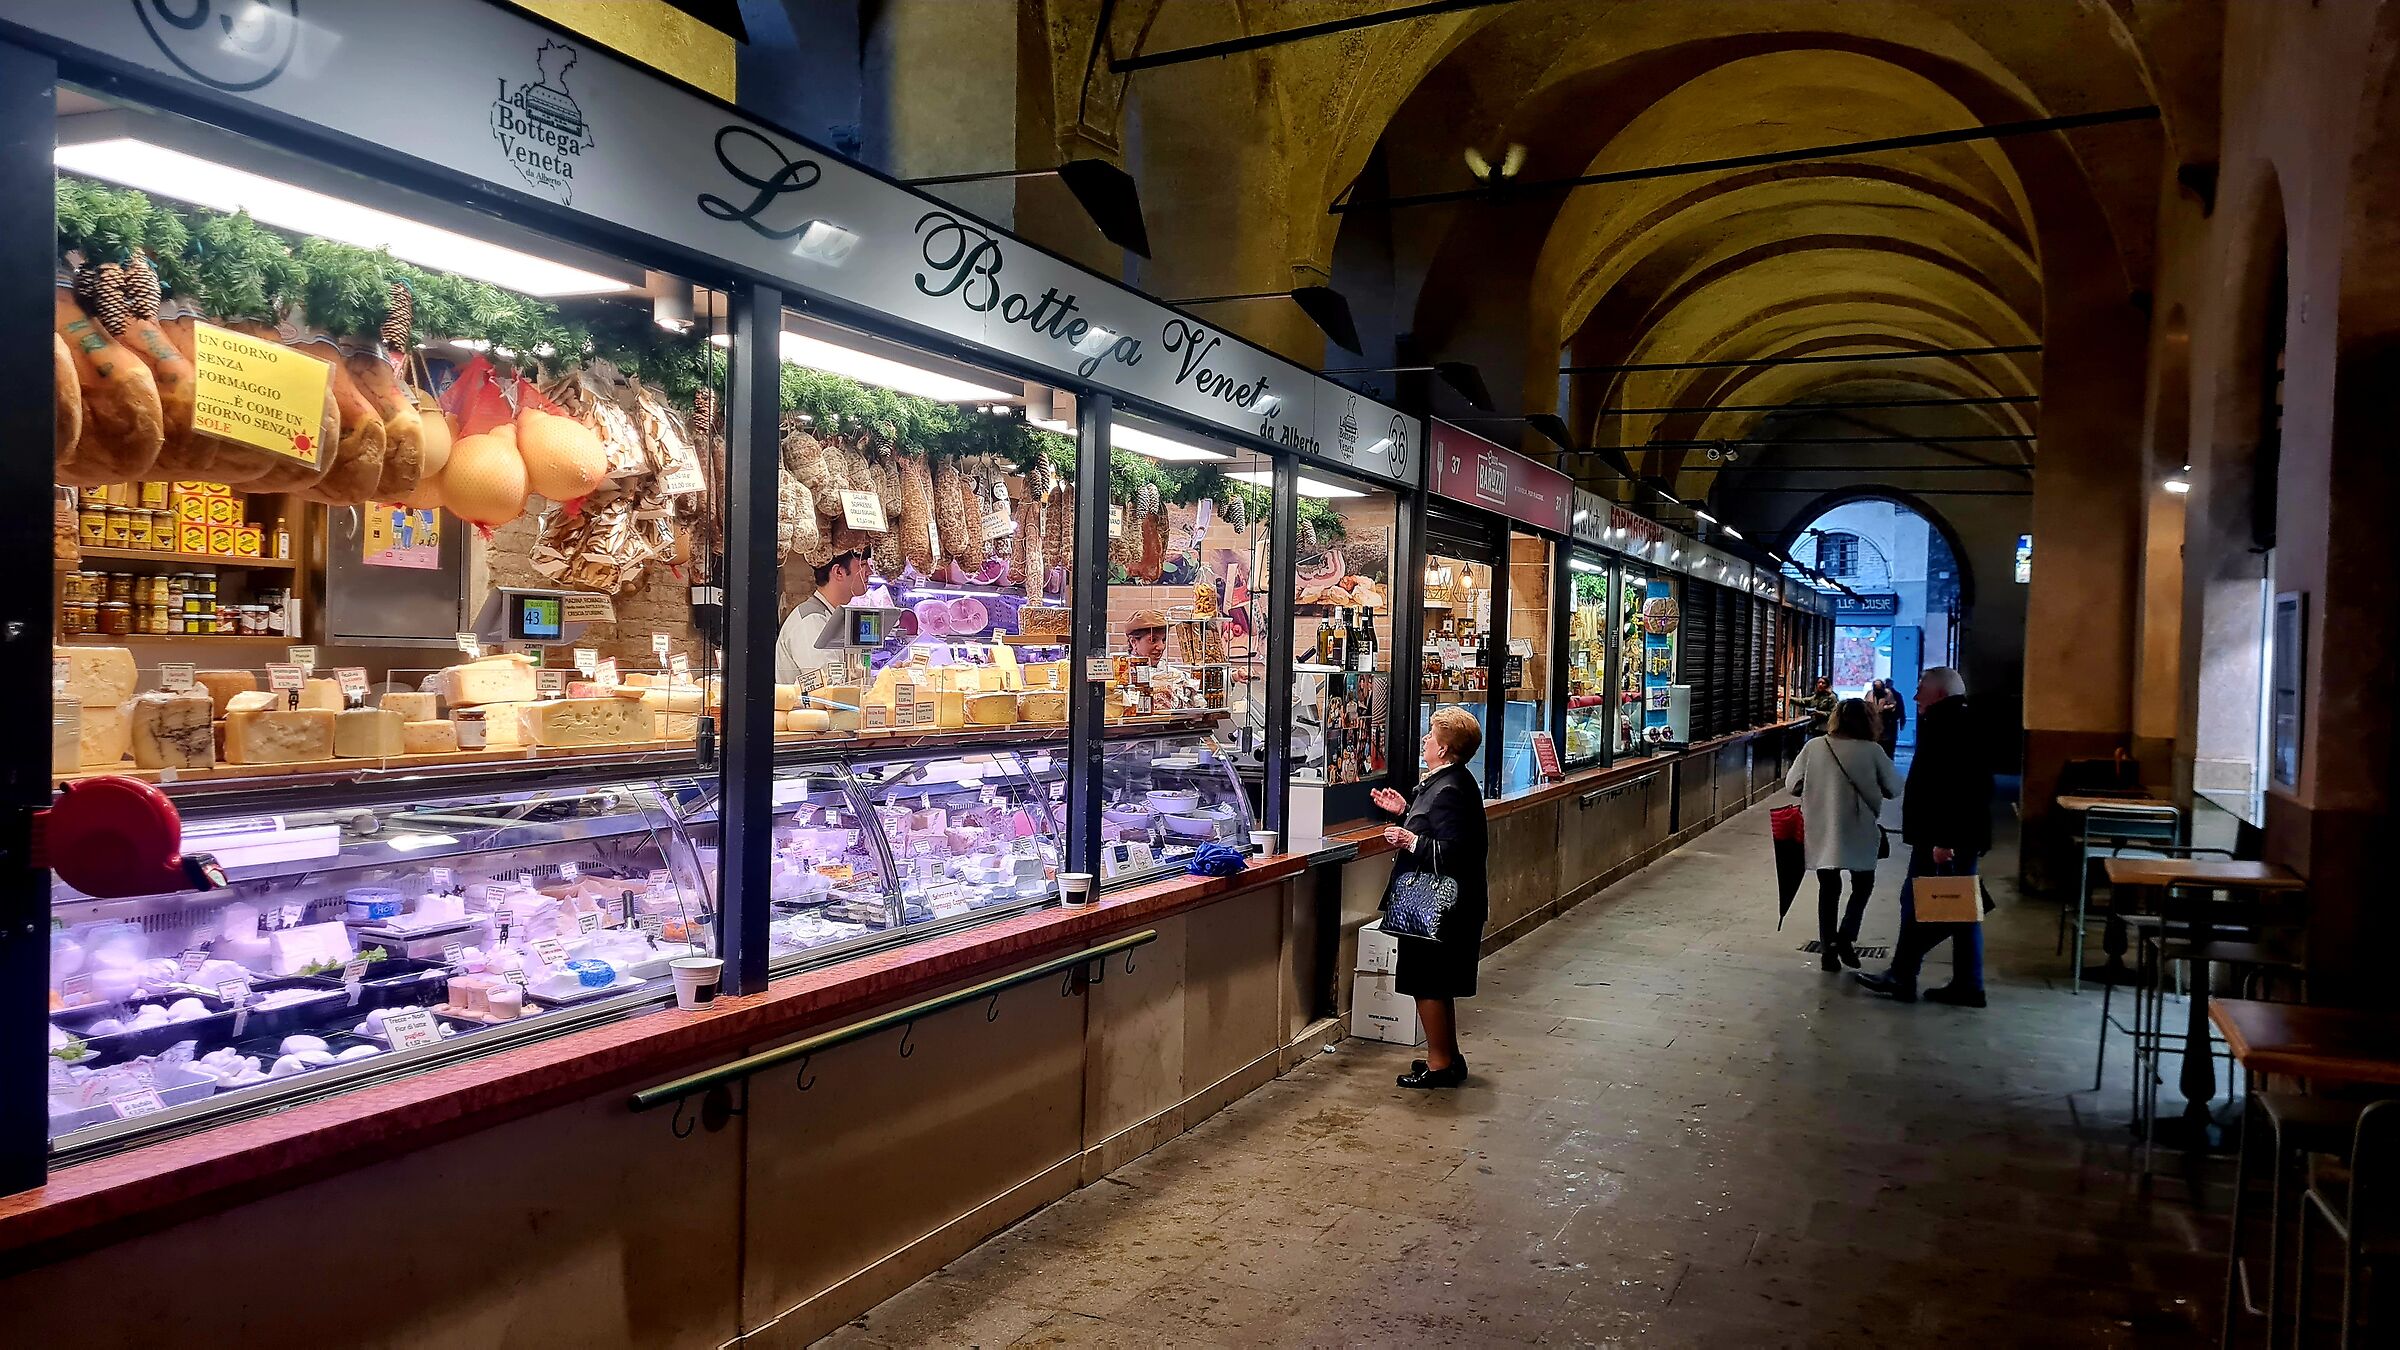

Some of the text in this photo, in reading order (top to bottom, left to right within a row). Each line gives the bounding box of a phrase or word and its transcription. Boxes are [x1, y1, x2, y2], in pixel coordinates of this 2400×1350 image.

[498, 77, 526, 110] La
[498, 104, 581, 156] Bottega
[498, 131, 573, 179] Veneta
[536, 170, 561, 186] Alberto
[198, 334, 278, 363] UN GIORNO
[198, 352, 243, 371] SENZA
[198, 369, 281, 400] FORMAGGIO
[196, 416, 232, 433] SOLE
[197, 402, 293, 439] GIORNO SENZA
[246, 401, 283, 420] COME
[286, 413, 303, 426] UN
[1260, 418, 1320, 454] da Alberto
[1391, 428, 1405, 465] 36
[1450, 455, 1461, 475] 37
[1555, 495, 1562, 512] 37
[525, 611, 540, 625] 43
